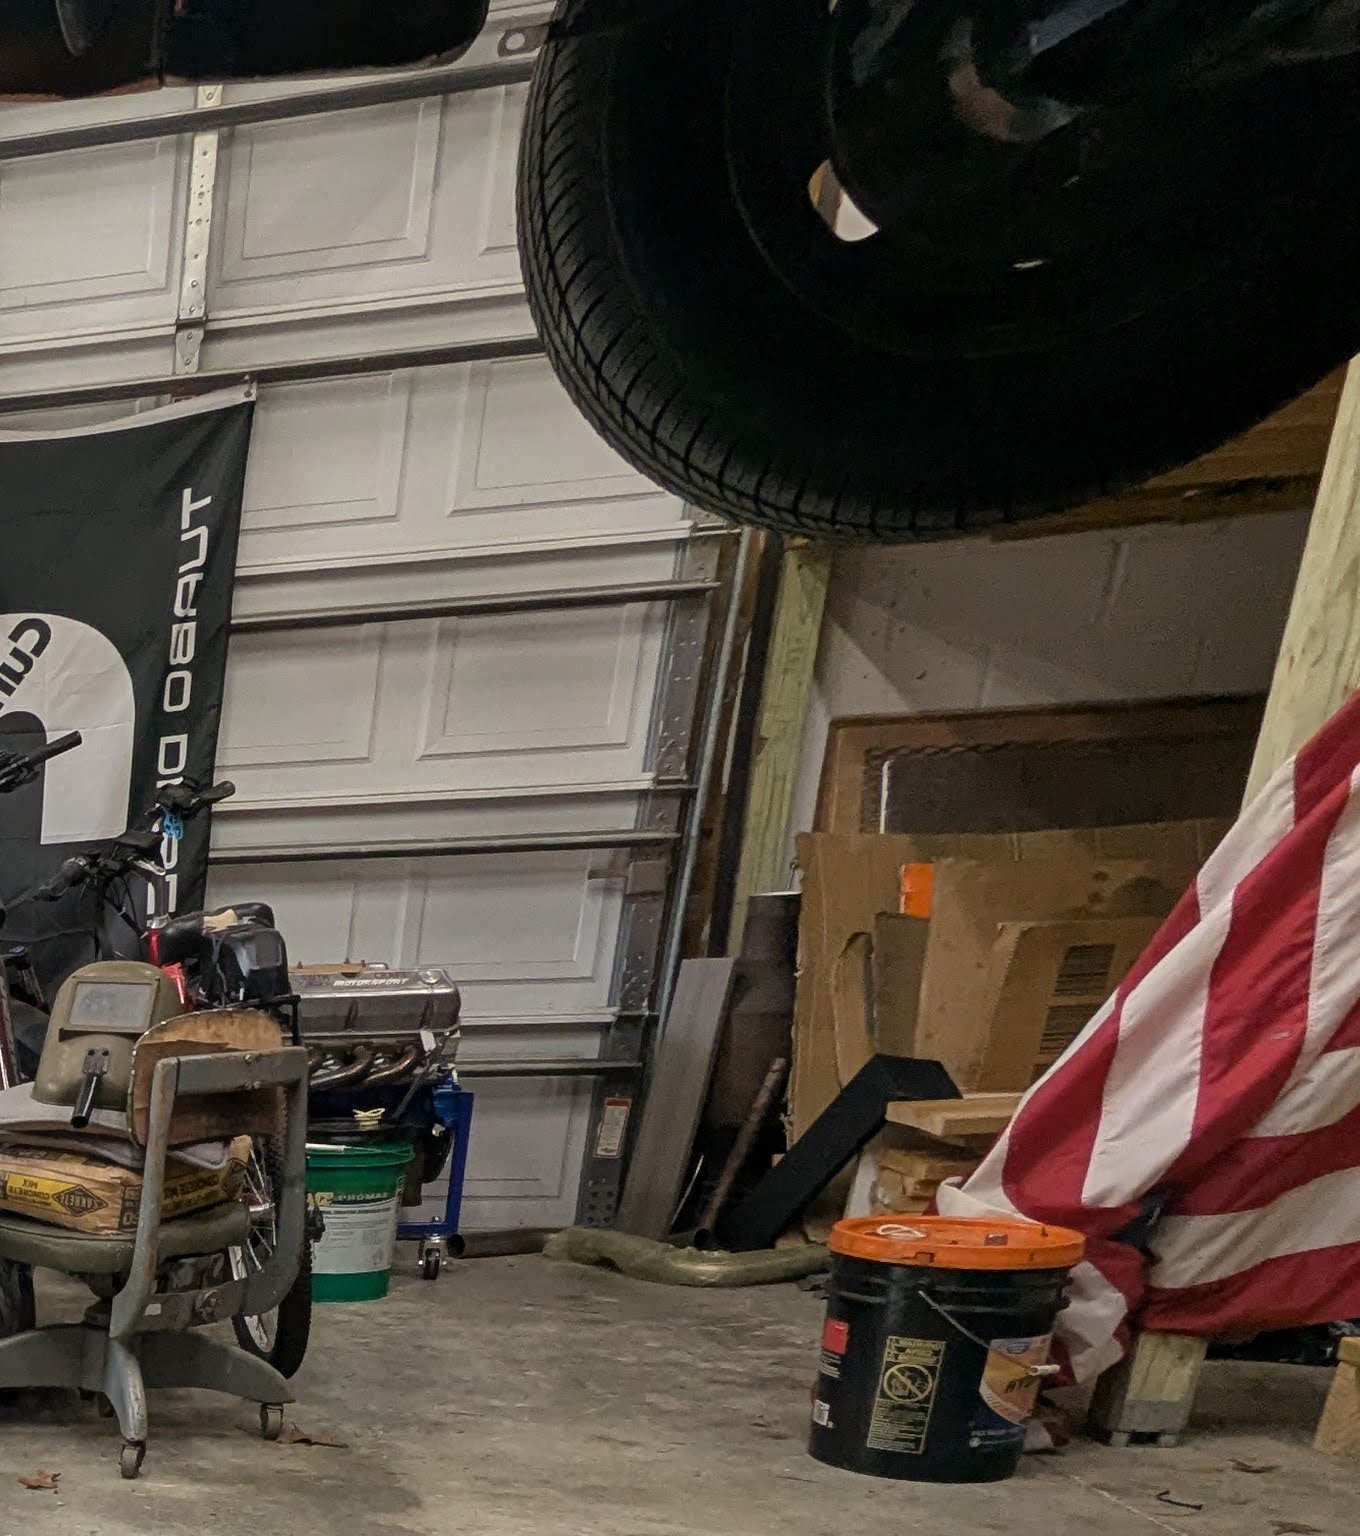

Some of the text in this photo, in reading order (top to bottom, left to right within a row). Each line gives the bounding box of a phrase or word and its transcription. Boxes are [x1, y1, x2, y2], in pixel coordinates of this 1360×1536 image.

[333, 977, 410, 987] MOTORSPORT
[21, 1178, 39, 1190] MIX
[8, 1185, 51, 1201] CONCRETE
[60, 1192, 99, 1211] SAKRETE
